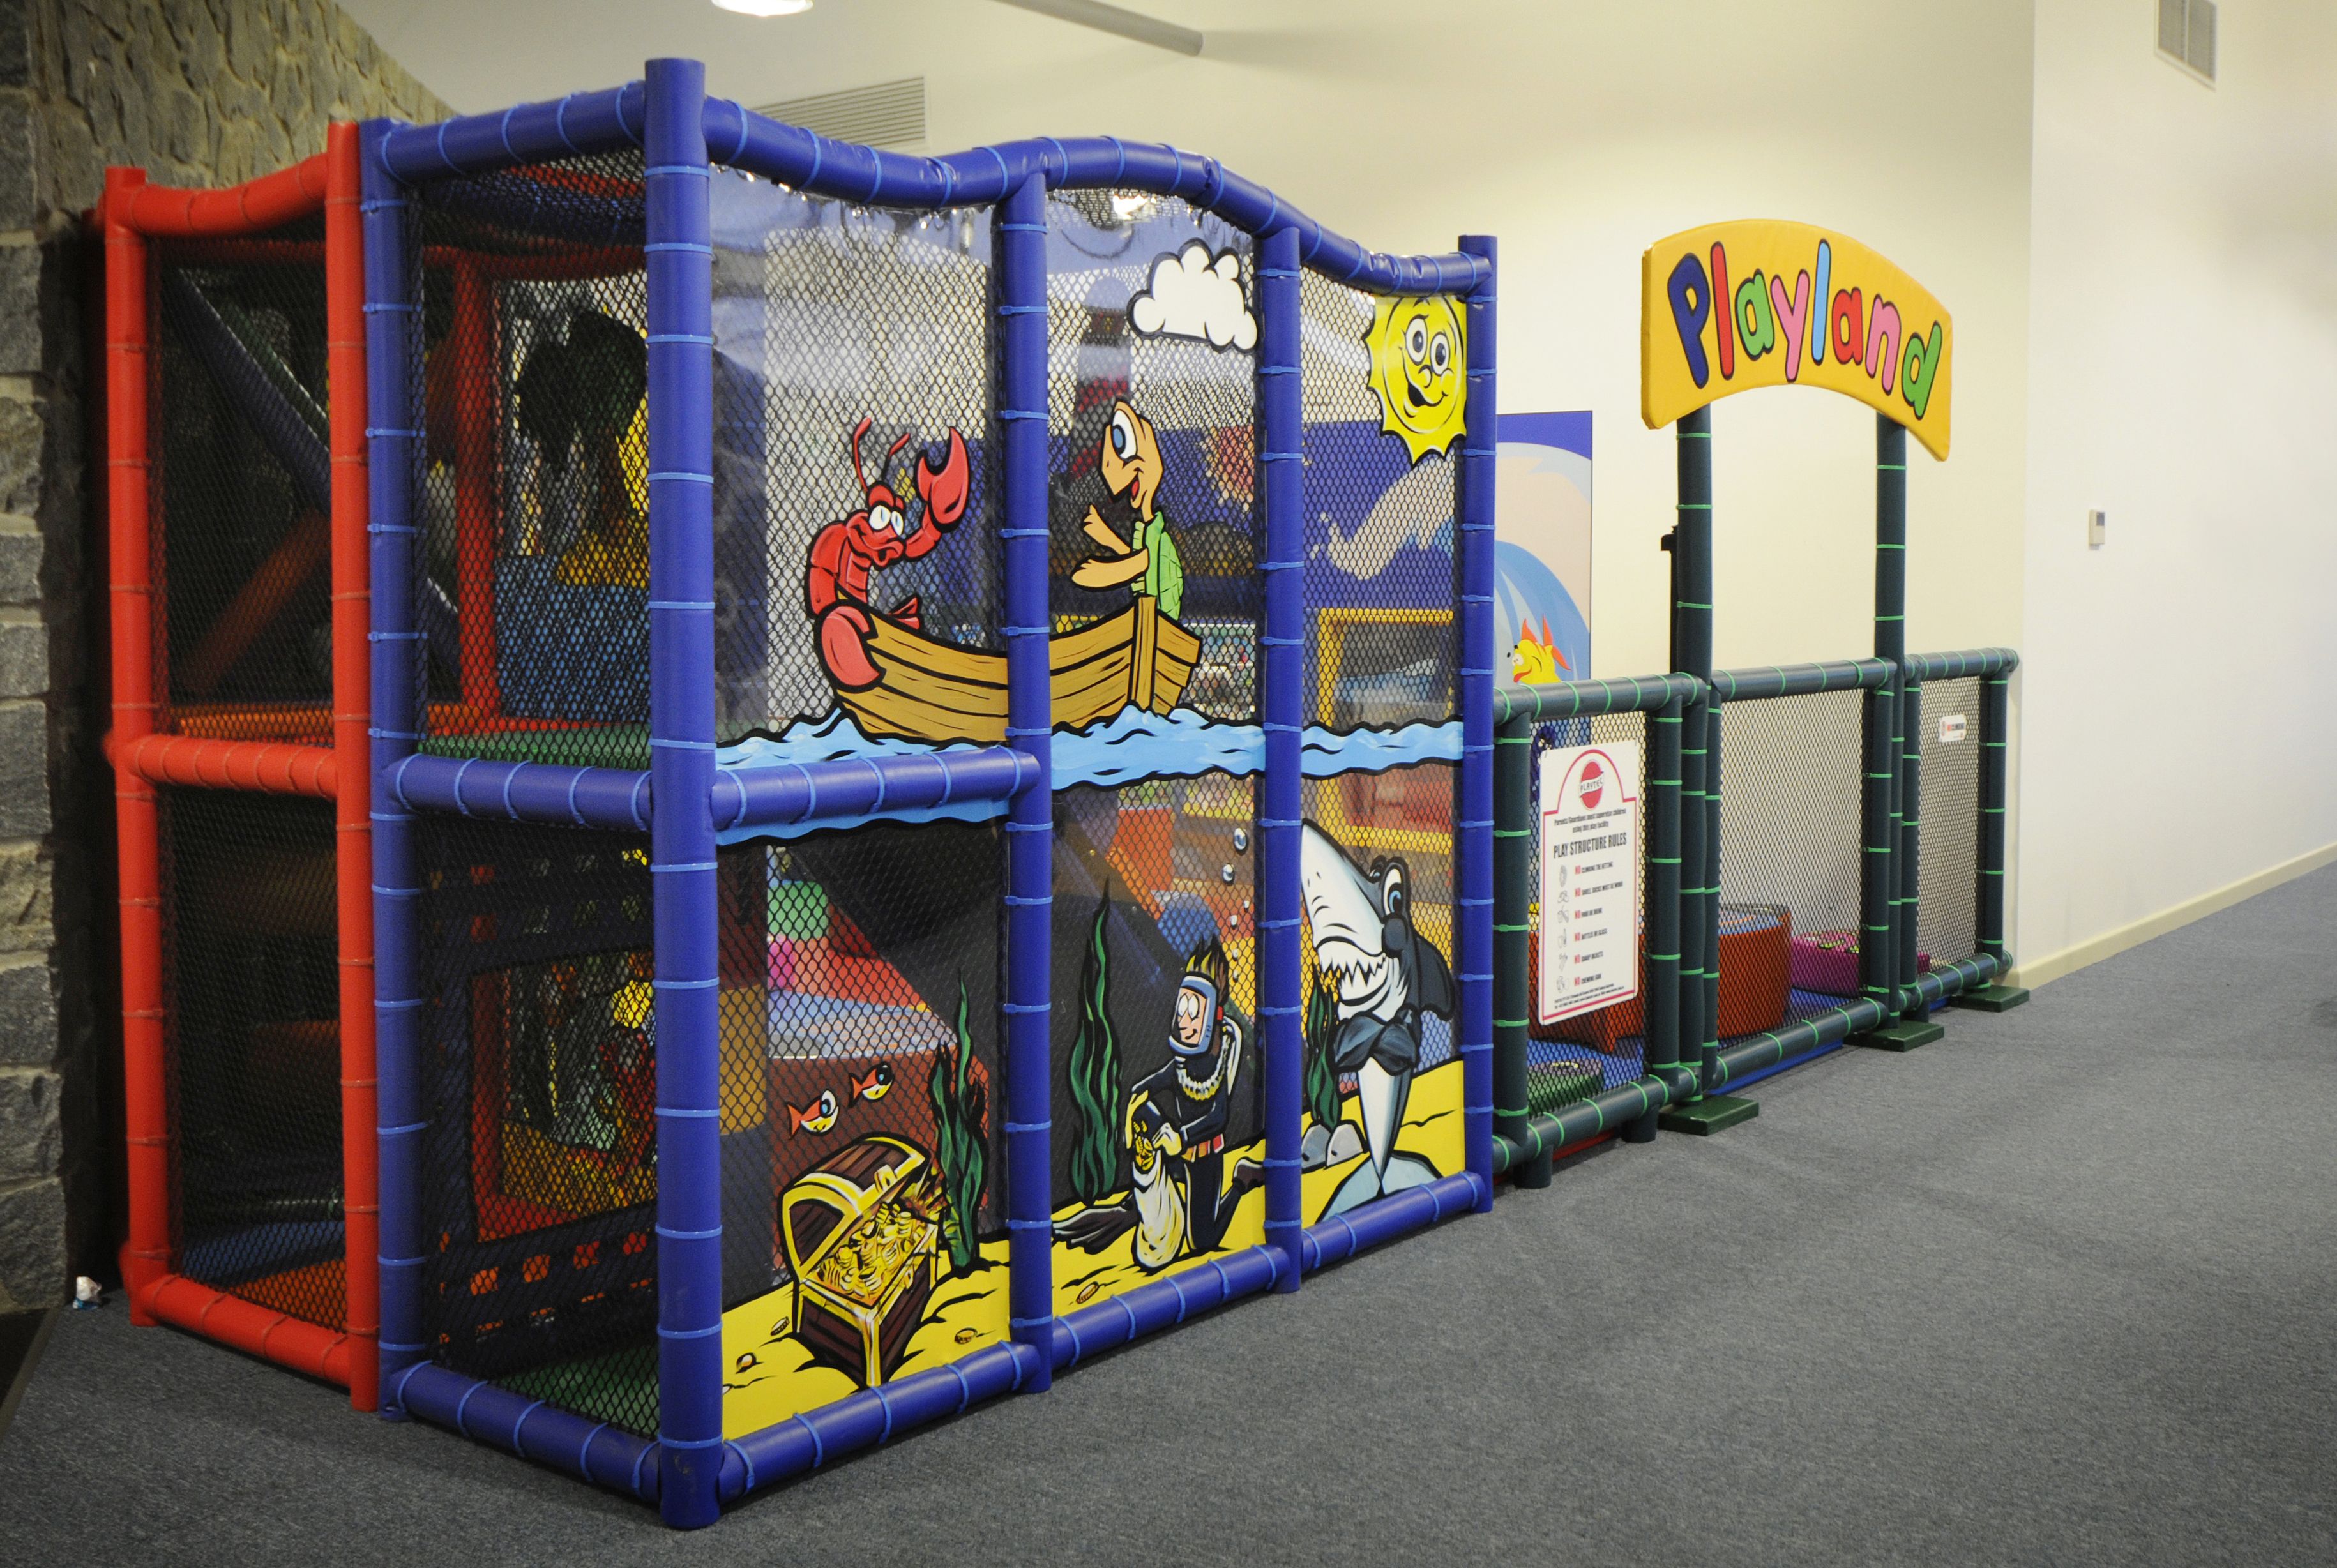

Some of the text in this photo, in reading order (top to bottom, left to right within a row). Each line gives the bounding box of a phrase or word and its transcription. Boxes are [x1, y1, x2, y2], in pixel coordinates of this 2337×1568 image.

[1667, 238, 1942, 421] Playland
[1580, 777, 1603, 791] PLAYTEC
[1554, 832, 1627, 859] PLAY STRUCTURE RULES
[1575, 866, 1580, 875] NO
[1575, 888, 1580, 897] NO
[1575, 910, 1580, 919] NO
[1575, 933, 1580, 941] NO
[1575, 955, 1580, 963] NO
[1575, 977, 1580, 986] NO
